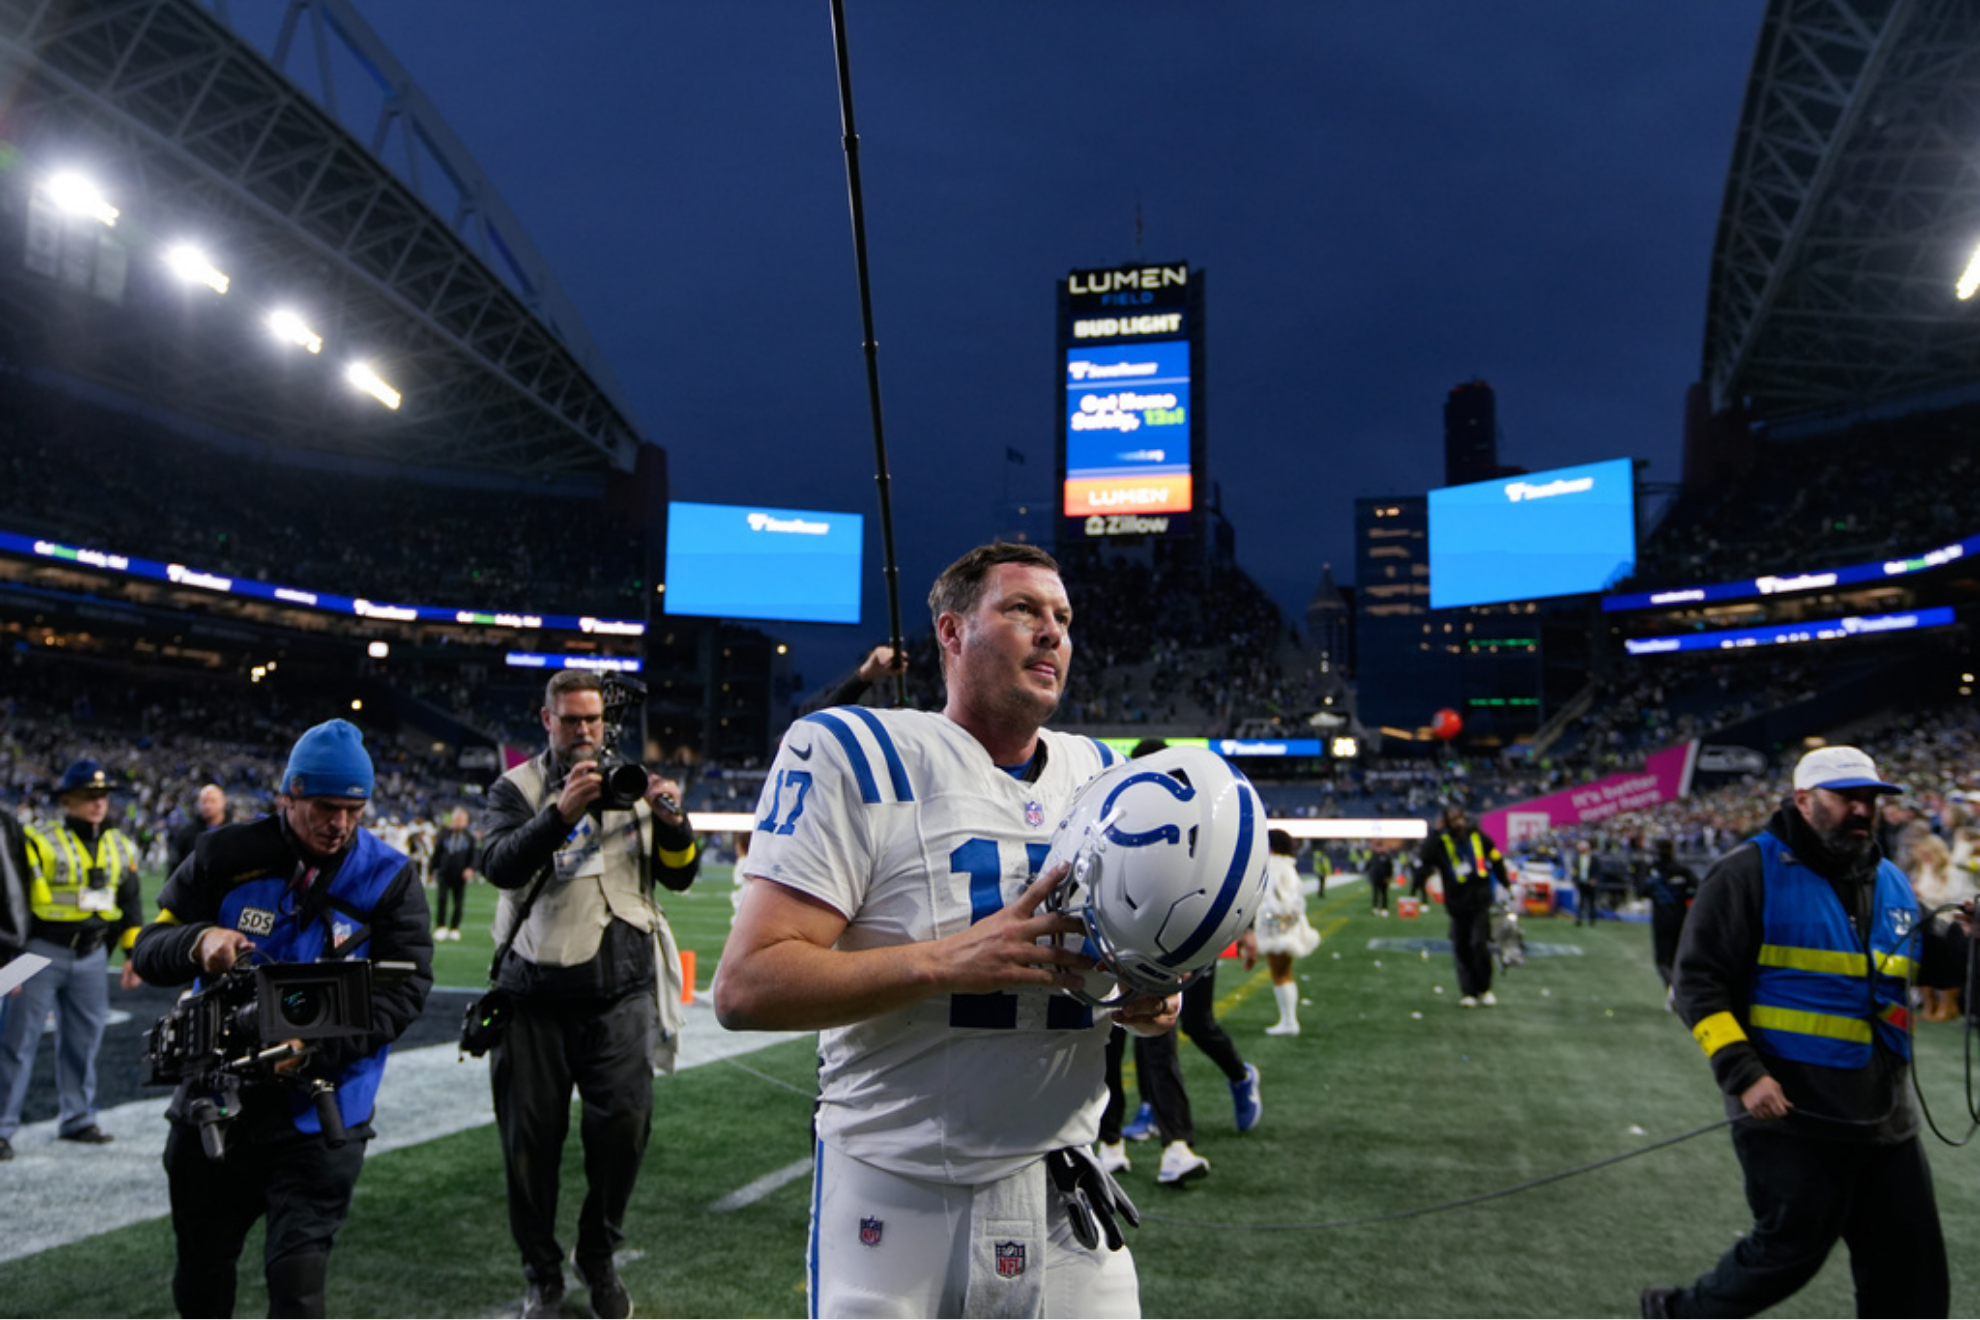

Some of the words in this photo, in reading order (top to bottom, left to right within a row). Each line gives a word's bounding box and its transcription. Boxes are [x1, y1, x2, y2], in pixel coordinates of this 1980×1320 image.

[1068, 266, 1187, 294] LUMEN
[1101, 291, 1154, 306] FIELD
[1073, 318, 1120, 338] BUD
[1120, 313, 1182, 335] LIGHT
[1088, 488, 1169, 506] LUMEN
[1107, 514, 1169, 534] Zillow
[1602, 774, 1659, 799] better
[757, 769, 813, 836] 17
[1618, 790, 1662, 812] here
[241, 911, 272, 930] SDS
